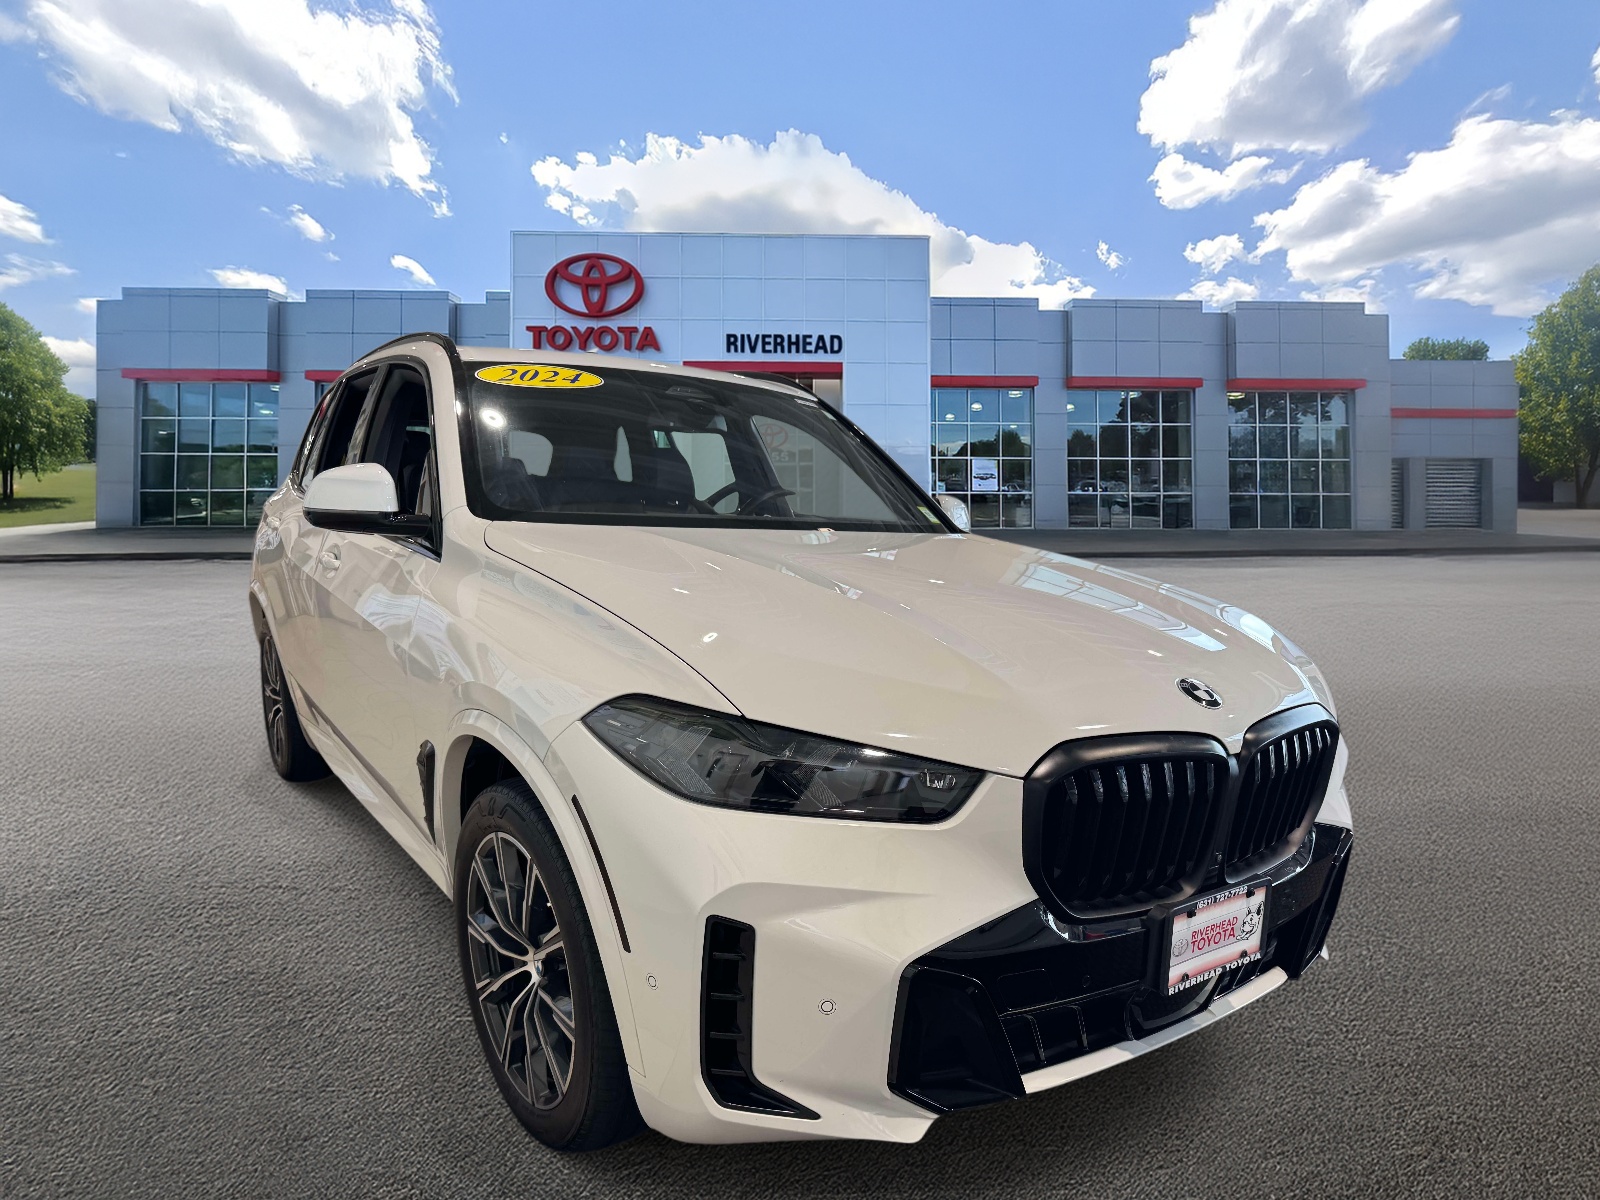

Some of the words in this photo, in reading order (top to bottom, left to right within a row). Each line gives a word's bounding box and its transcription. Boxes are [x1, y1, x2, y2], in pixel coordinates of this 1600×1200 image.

[525, 325, 661, 352] TOYOTA
[725, 333, 843, 355] RIVERHEAD
[496, 368, 583, 384] 2024
[1191, 916, 1238, 940] RIVERHEAD
[1191, 927, 1236, 953] TOYOTA
[1168, 965, 1223, 996] RIVERHEAD
[1226, 952, 1262, 972] TOYOTA
